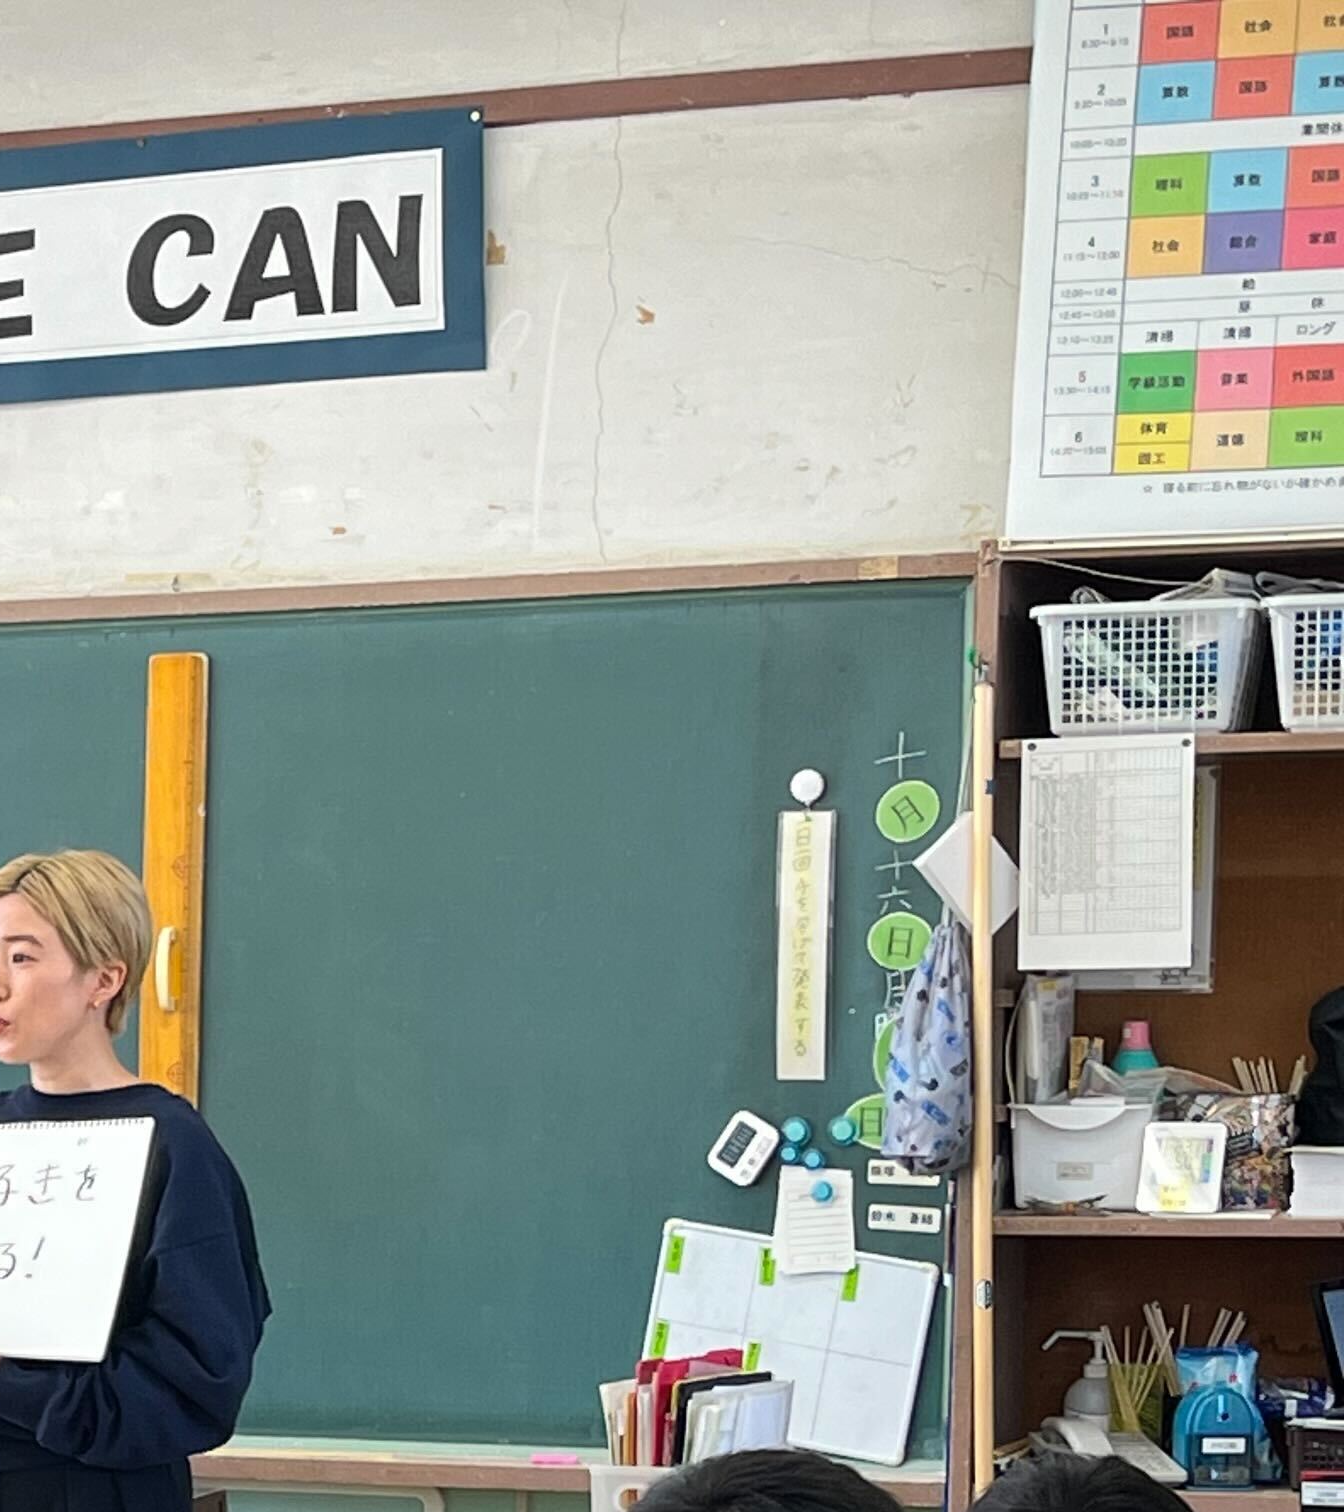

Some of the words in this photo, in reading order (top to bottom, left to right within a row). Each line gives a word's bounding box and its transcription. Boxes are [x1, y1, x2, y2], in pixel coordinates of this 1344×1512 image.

[1166, 24, 1195, 40] 国語
[1244, 19, 1272, 34] 社会
[1097, 84, 1106, 97] 2
[1162, 85, 1190, 100] 算数
[1091, 175, 1100, 188] 3
[1155, 178, 1183, 192] 理科
[1233, 174, 1261, 188] 算数
[1311, 169, 1340, 183] 国語
[1088, 236, 1095, 248] 4
[1152, 239, 1180, 253] 社会
[125, 194, 424, 327] CAN
[1128, 375, 1185, 389] 学級活動
[1221, 373, 1249, 386] 音楽
[1292, 369, 1335, 383] 外国語
[1140, 422, 1167, 435] 体育
[1295, 430, 1322, 443] 理科
